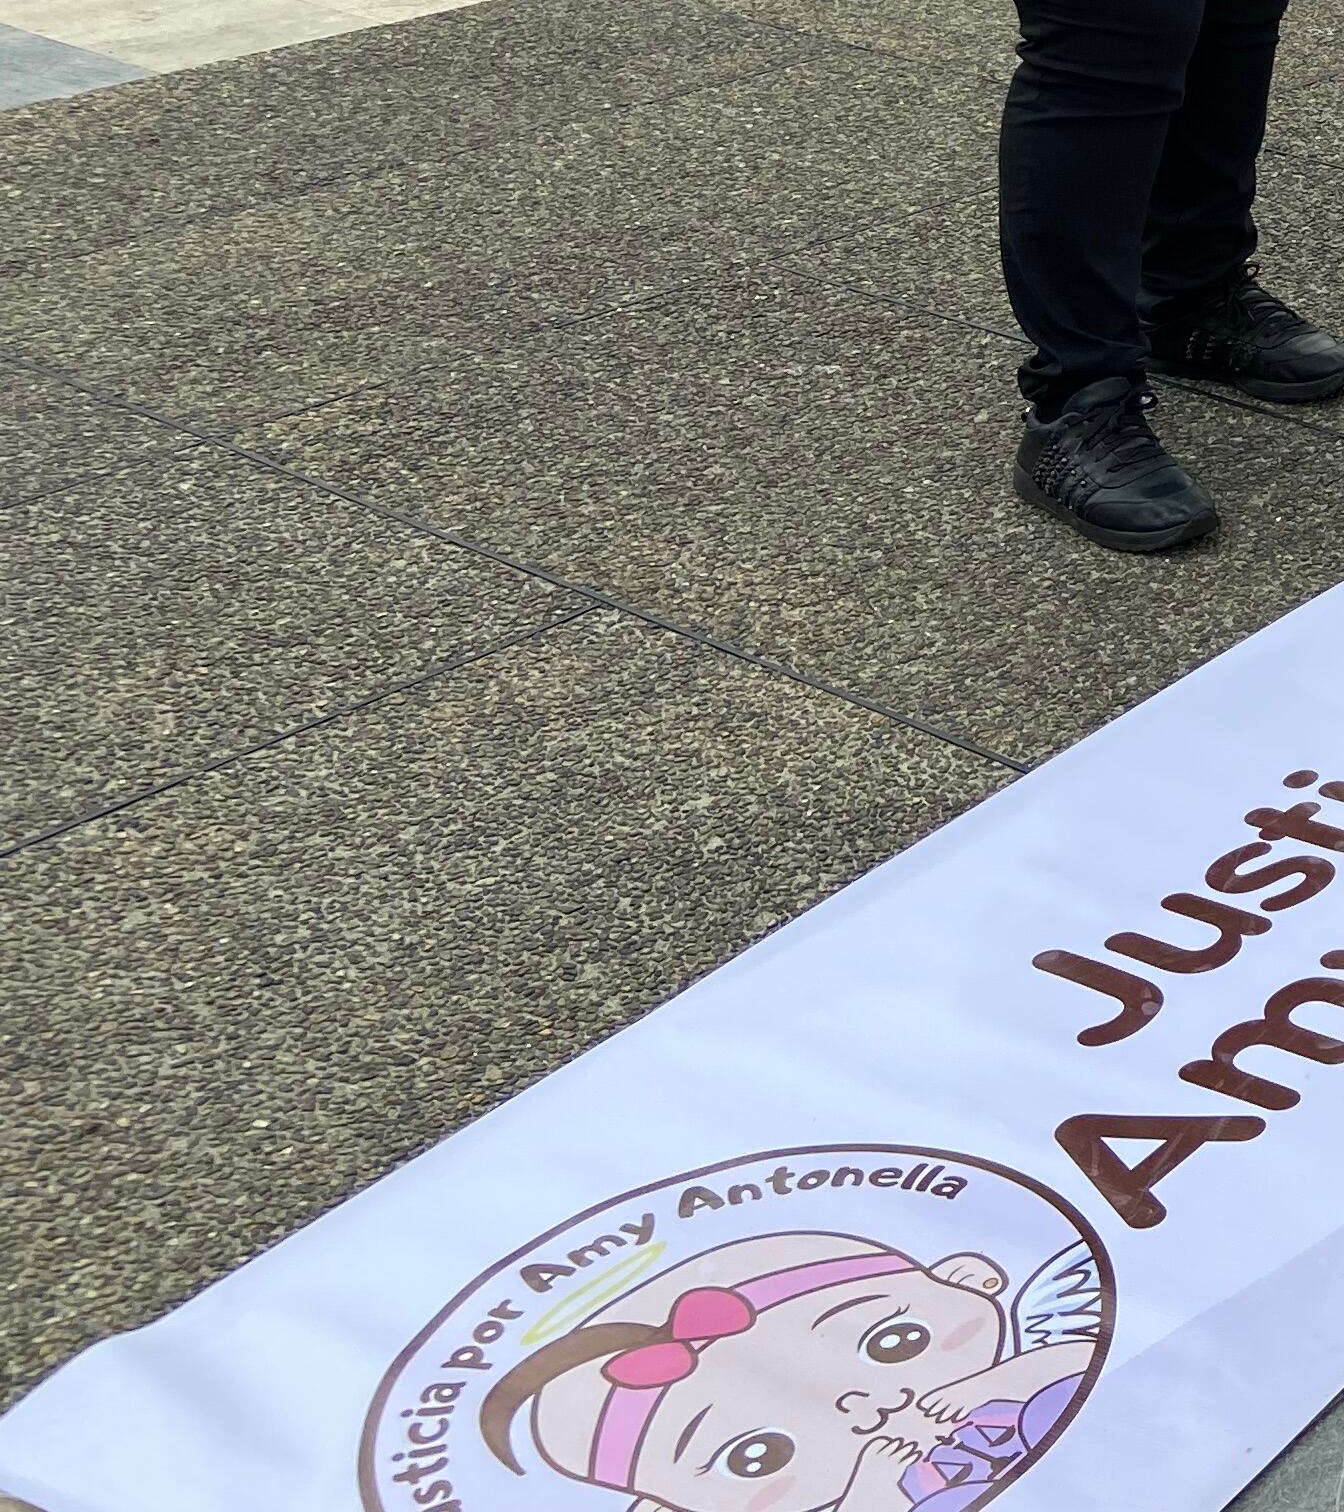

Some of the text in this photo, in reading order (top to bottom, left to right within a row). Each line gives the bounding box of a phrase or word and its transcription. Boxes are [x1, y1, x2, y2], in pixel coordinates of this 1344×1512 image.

[390, 1161, 969, 1512] sticia por Amy Antonella
